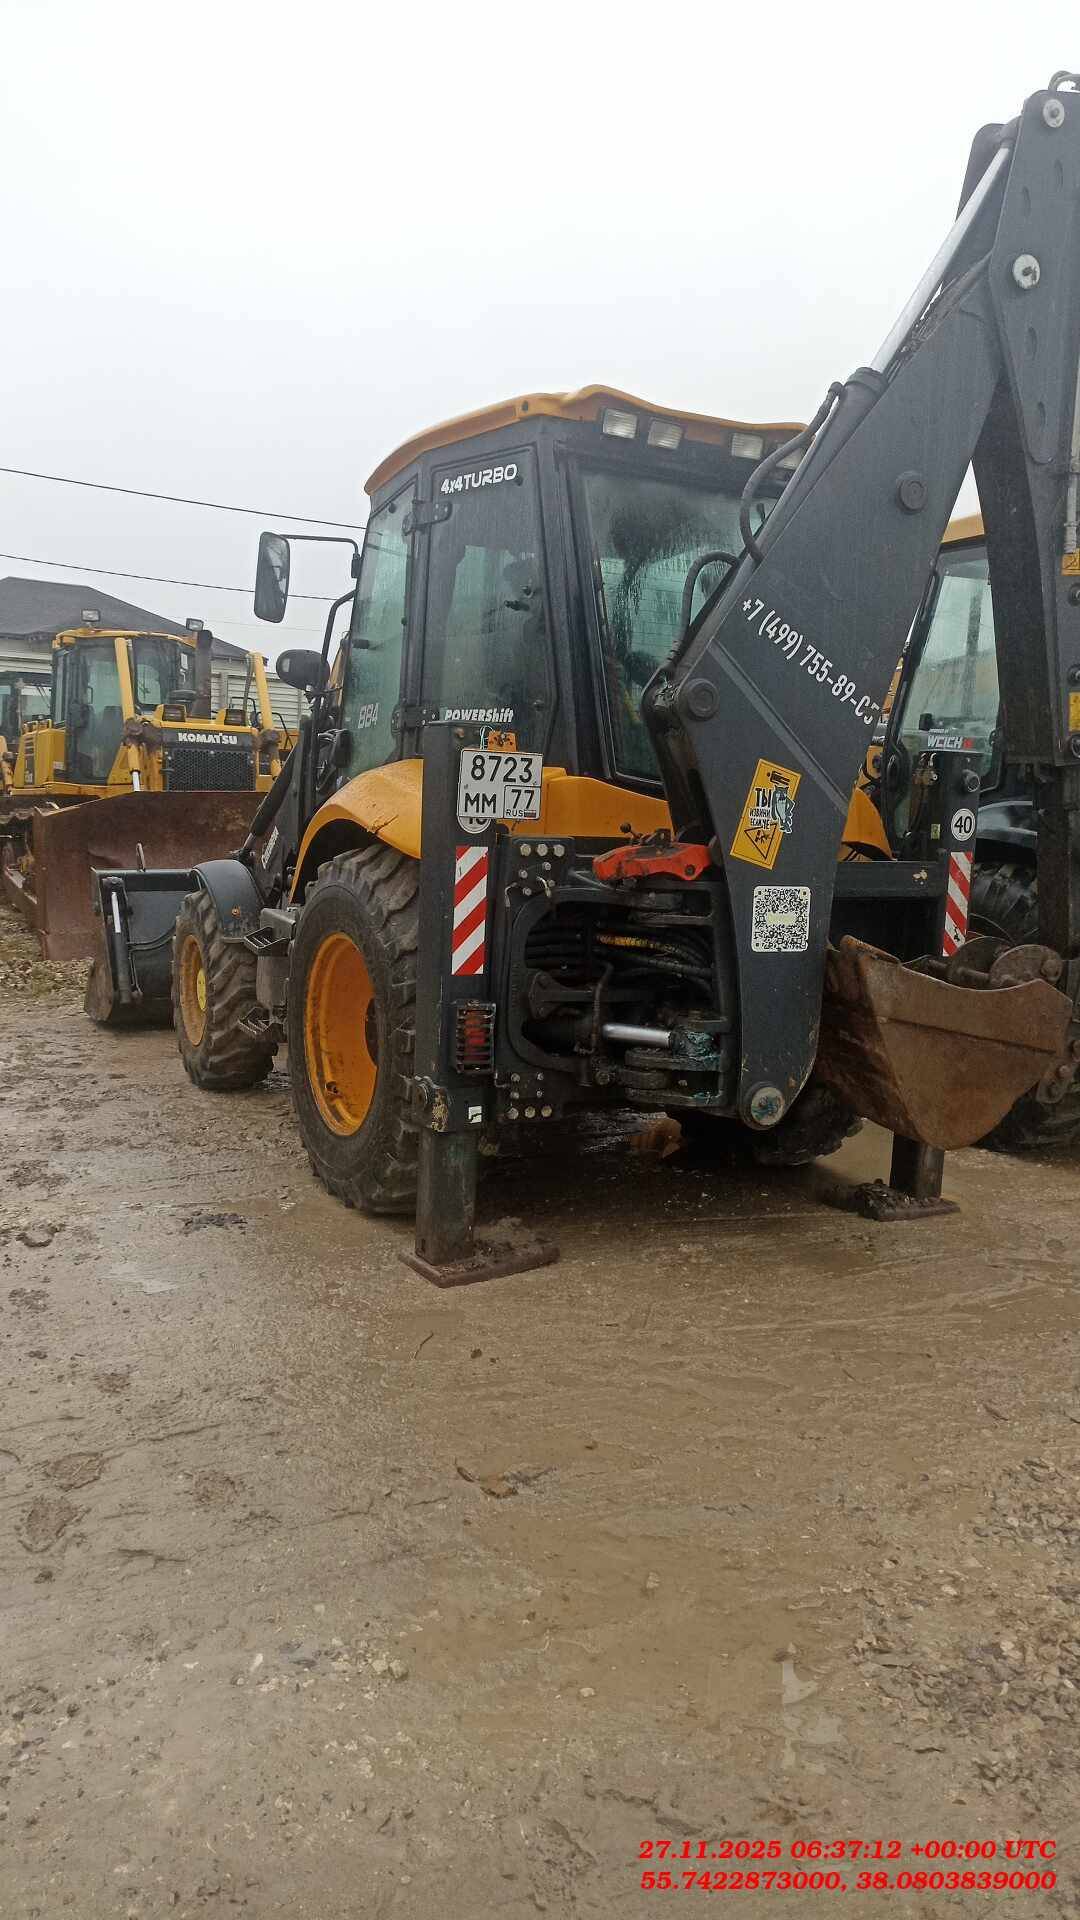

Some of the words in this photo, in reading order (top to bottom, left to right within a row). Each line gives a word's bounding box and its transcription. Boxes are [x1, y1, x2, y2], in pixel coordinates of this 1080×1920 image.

[743, 598, 764, 621] +7
[758, 609, 803, 660] (499)
[178, 732, 238, 745] KOMATSU
[471, 754, 533, 783] 8723
[511, 789, 535, 809] 77
[756, 787, 771, 808] ТЫ
[506, 809, 524, 817] RUS
[954, 815, 973, 834] 40
